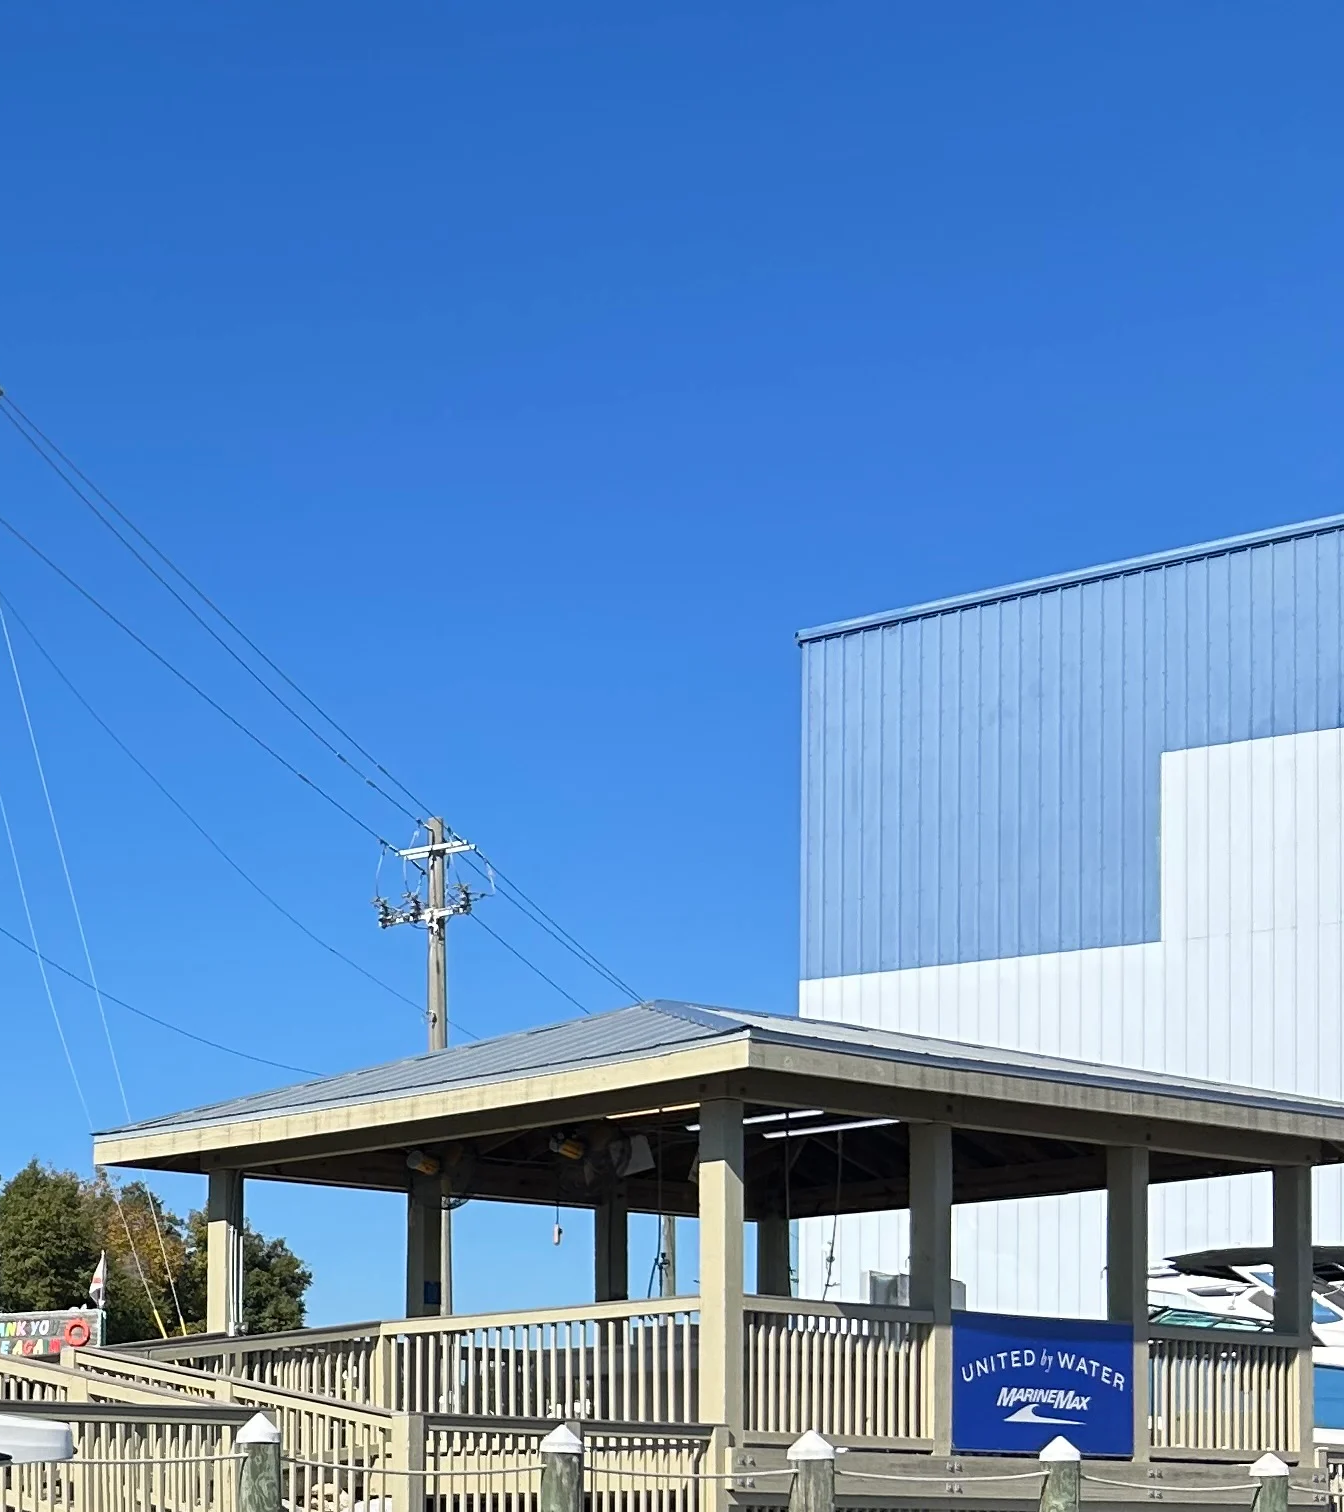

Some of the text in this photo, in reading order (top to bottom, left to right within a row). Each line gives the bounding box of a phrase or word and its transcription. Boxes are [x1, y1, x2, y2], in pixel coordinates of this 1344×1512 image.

[961, 1347, 1125, 1392] UNITED by WATER
